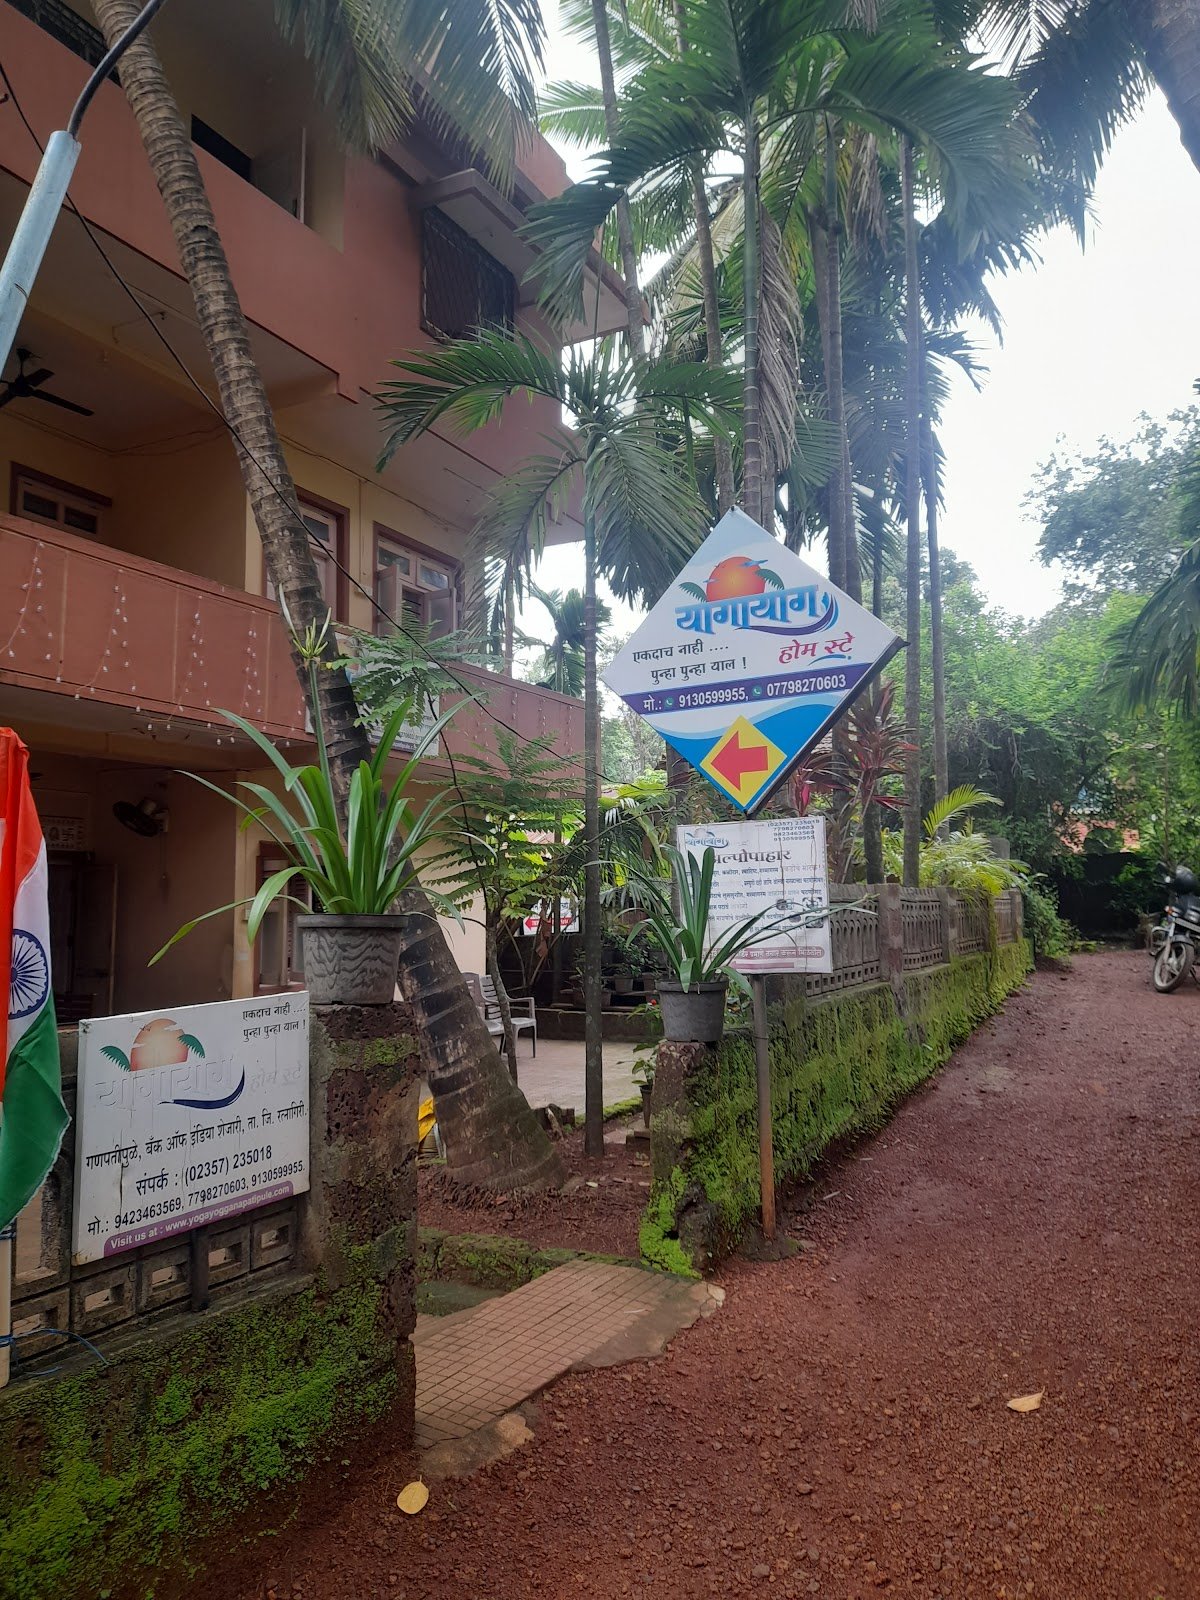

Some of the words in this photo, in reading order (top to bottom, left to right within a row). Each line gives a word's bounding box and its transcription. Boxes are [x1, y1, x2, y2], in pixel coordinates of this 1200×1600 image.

[632, 646, 674, 663] एकदाच
[678, 639, 704, 655] नाही
[779, 639, 819, 664] होम
[824, 631, 855, 654] स्टे
[651, 667, 676, 685] पुन्हा
[680, 662, 706, 681] पुन्हा
[710, 658, 736, 672] याल
[742, 656, 747, 669] !
[679, 686, 749, 708] 9130599955,
[766, 674, 847, 696] 07798270603
[242, 1008, 271, 1021] एकदाच
[274, 1001, 290, 1016] नाही
[243, 1026, 261, 1042] पुन्हा
[263, 1023, 281, 1039] पुन्हा
[283, 1020, 299, 1031] याल
[86, 1139, 142, 1170] गणपतीपुळे,
[190, 1123, 215, 1147] इंडिया
[217, 1117, 245, 1138] शेजारी,
[247, 1116, 259, 1131] ता.
[262, 1108, 275, 1127] जि.
[136, 1167, 169, 1196] संपर्क
[184, 1156, 230, 1187] (02357)
[232, 1144, 272, 1170] 235018
[110, 1235, 133, 1249] Visit
[134, 1231, 147, 1242] us
[148, 1226, 159, 1238] at
[165, 1184, 290, 1232] www.yogayogganapatipule.com
[114, 1197, 185, 1229] 9423463569,
[188, 1177, 250, 1207] 7798270603,
